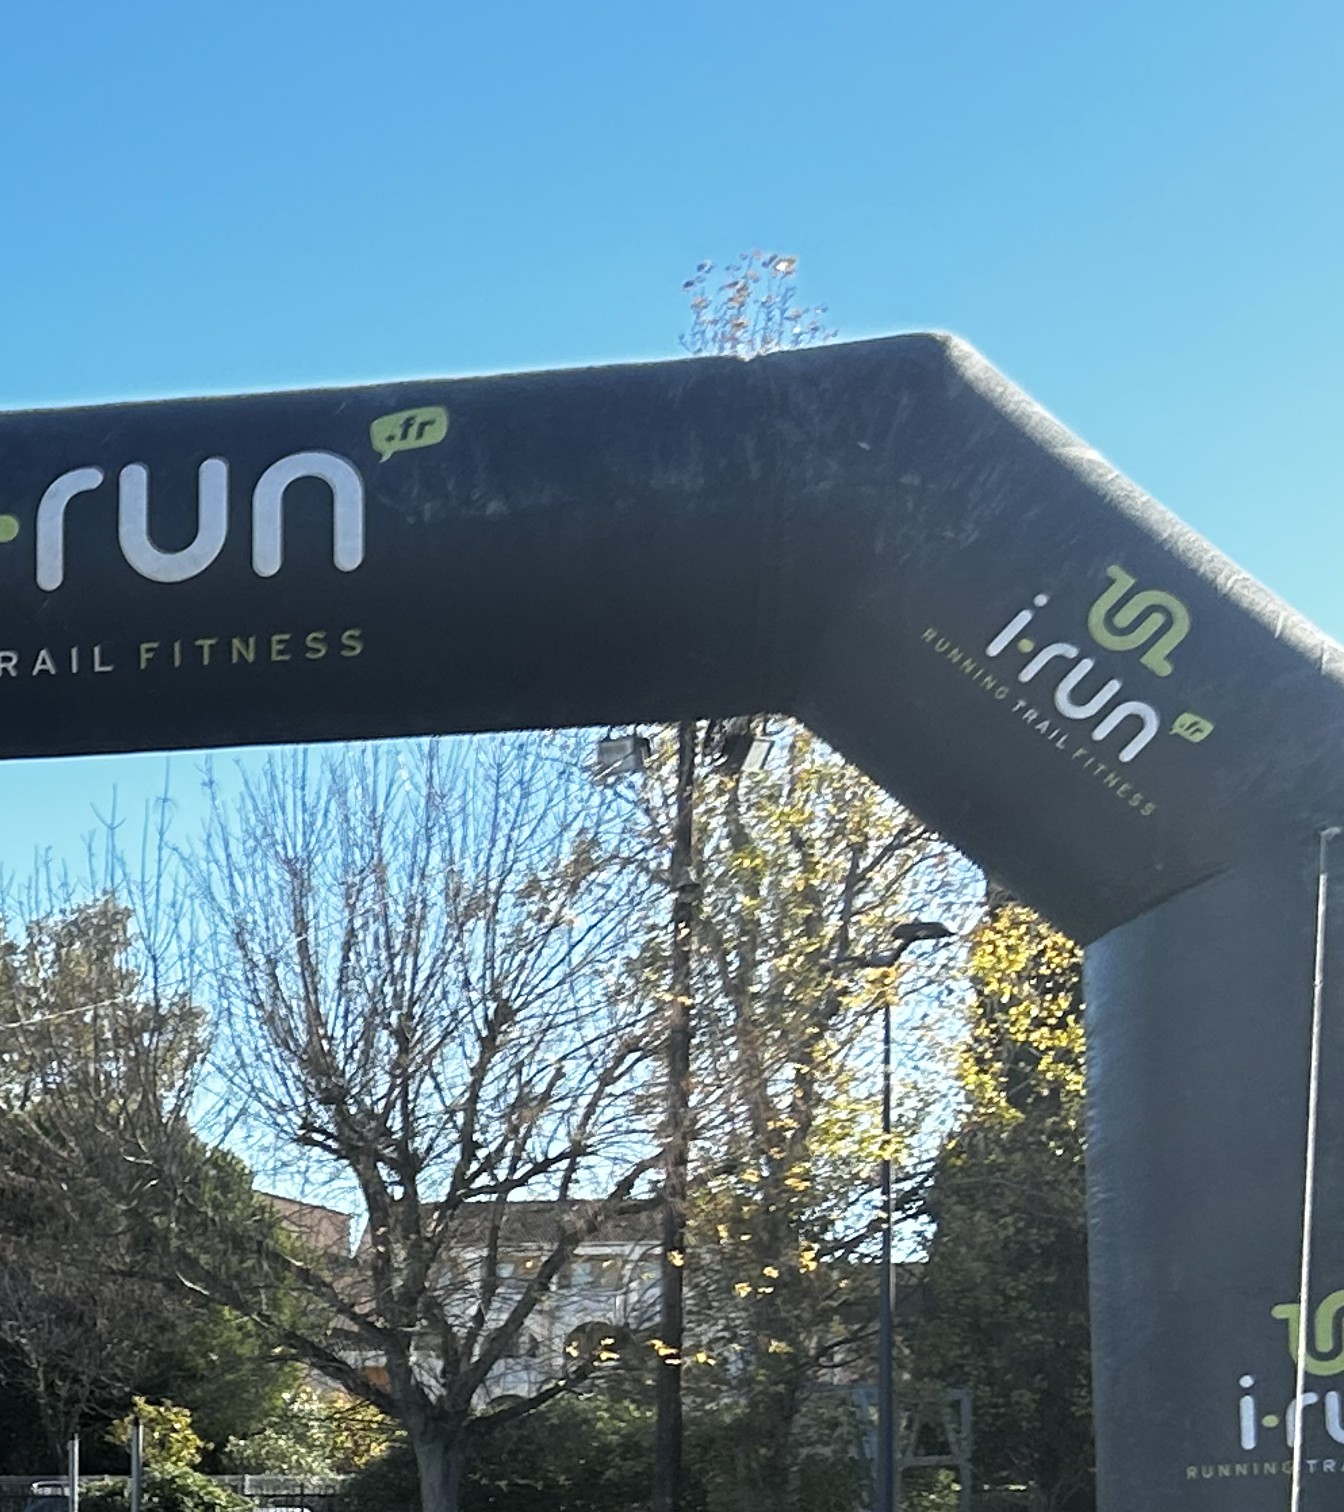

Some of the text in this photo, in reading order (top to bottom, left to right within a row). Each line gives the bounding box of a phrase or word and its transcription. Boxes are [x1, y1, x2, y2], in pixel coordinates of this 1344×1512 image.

[139, 627, 366, 670] FITNESS
[921, 627, 1157, 817] RUNNING TRAIL FITNESS
[1306, 1458, 1344, 1474] TR
